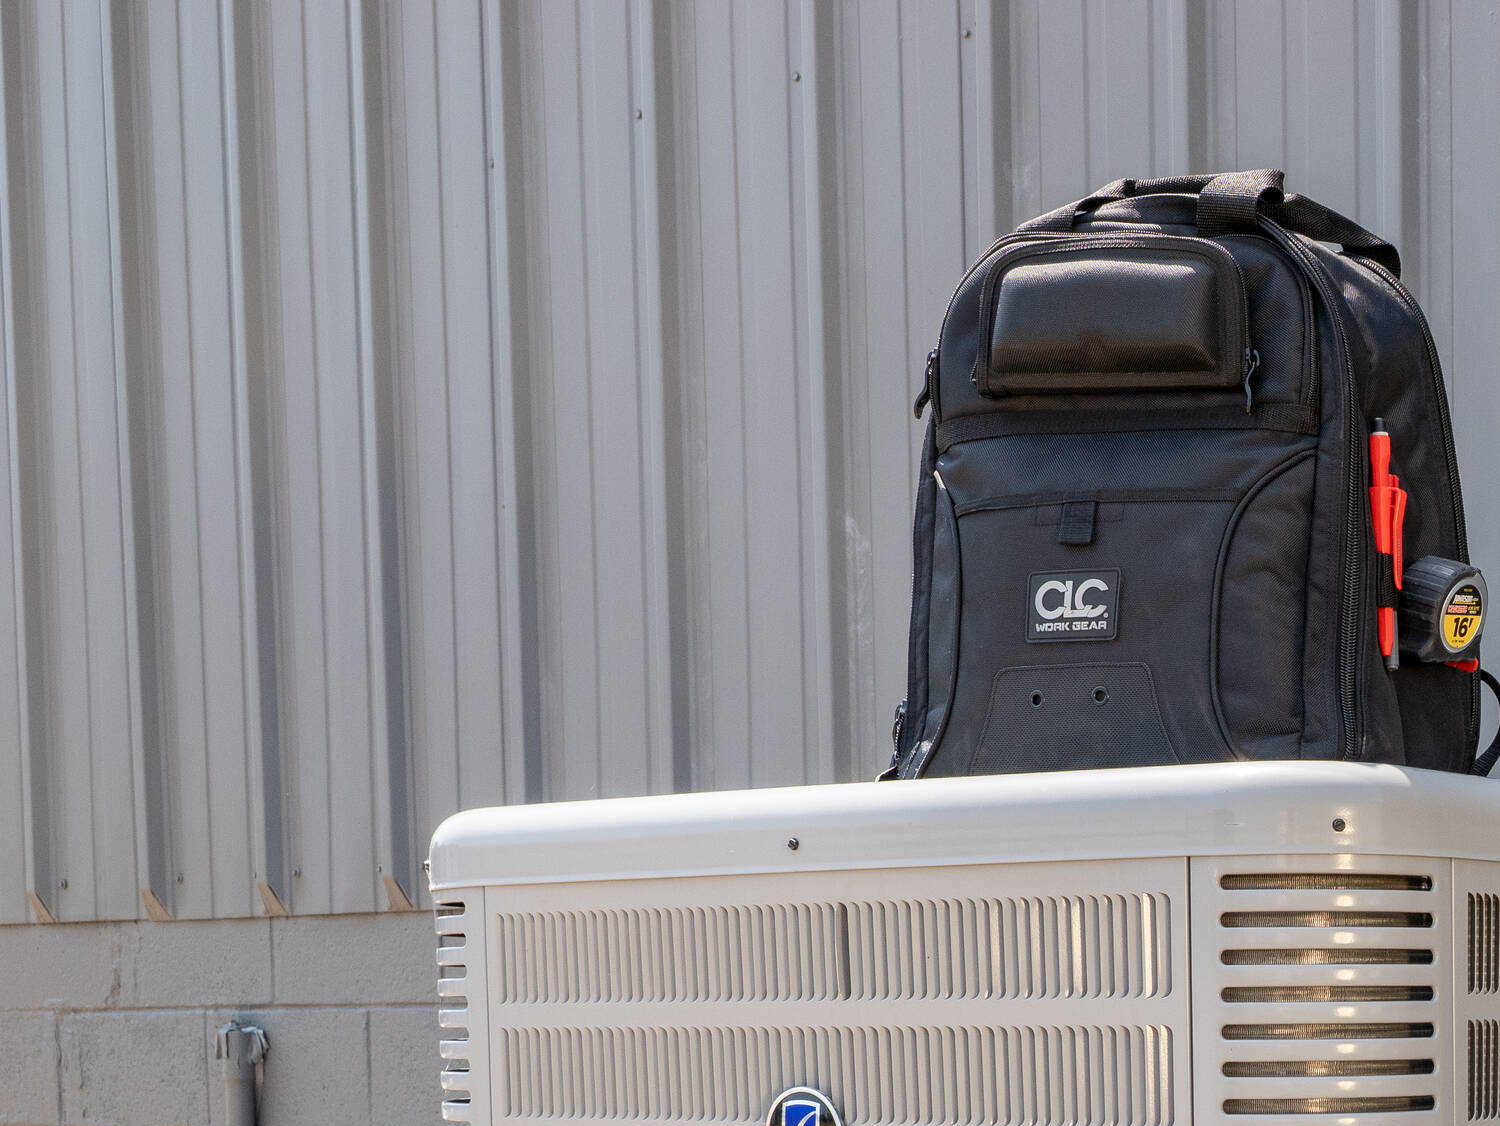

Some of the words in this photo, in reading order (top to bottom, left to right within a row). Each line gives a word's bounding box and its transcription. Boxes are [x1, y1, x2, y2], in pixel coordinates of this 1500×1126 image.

[1034, 578, 1109, 620] CLC
[1035, 621, 1070, 632] WORK
[1072, 620, 1107, 631] GEAR
[1453, 617, 1474, 638] 16'
